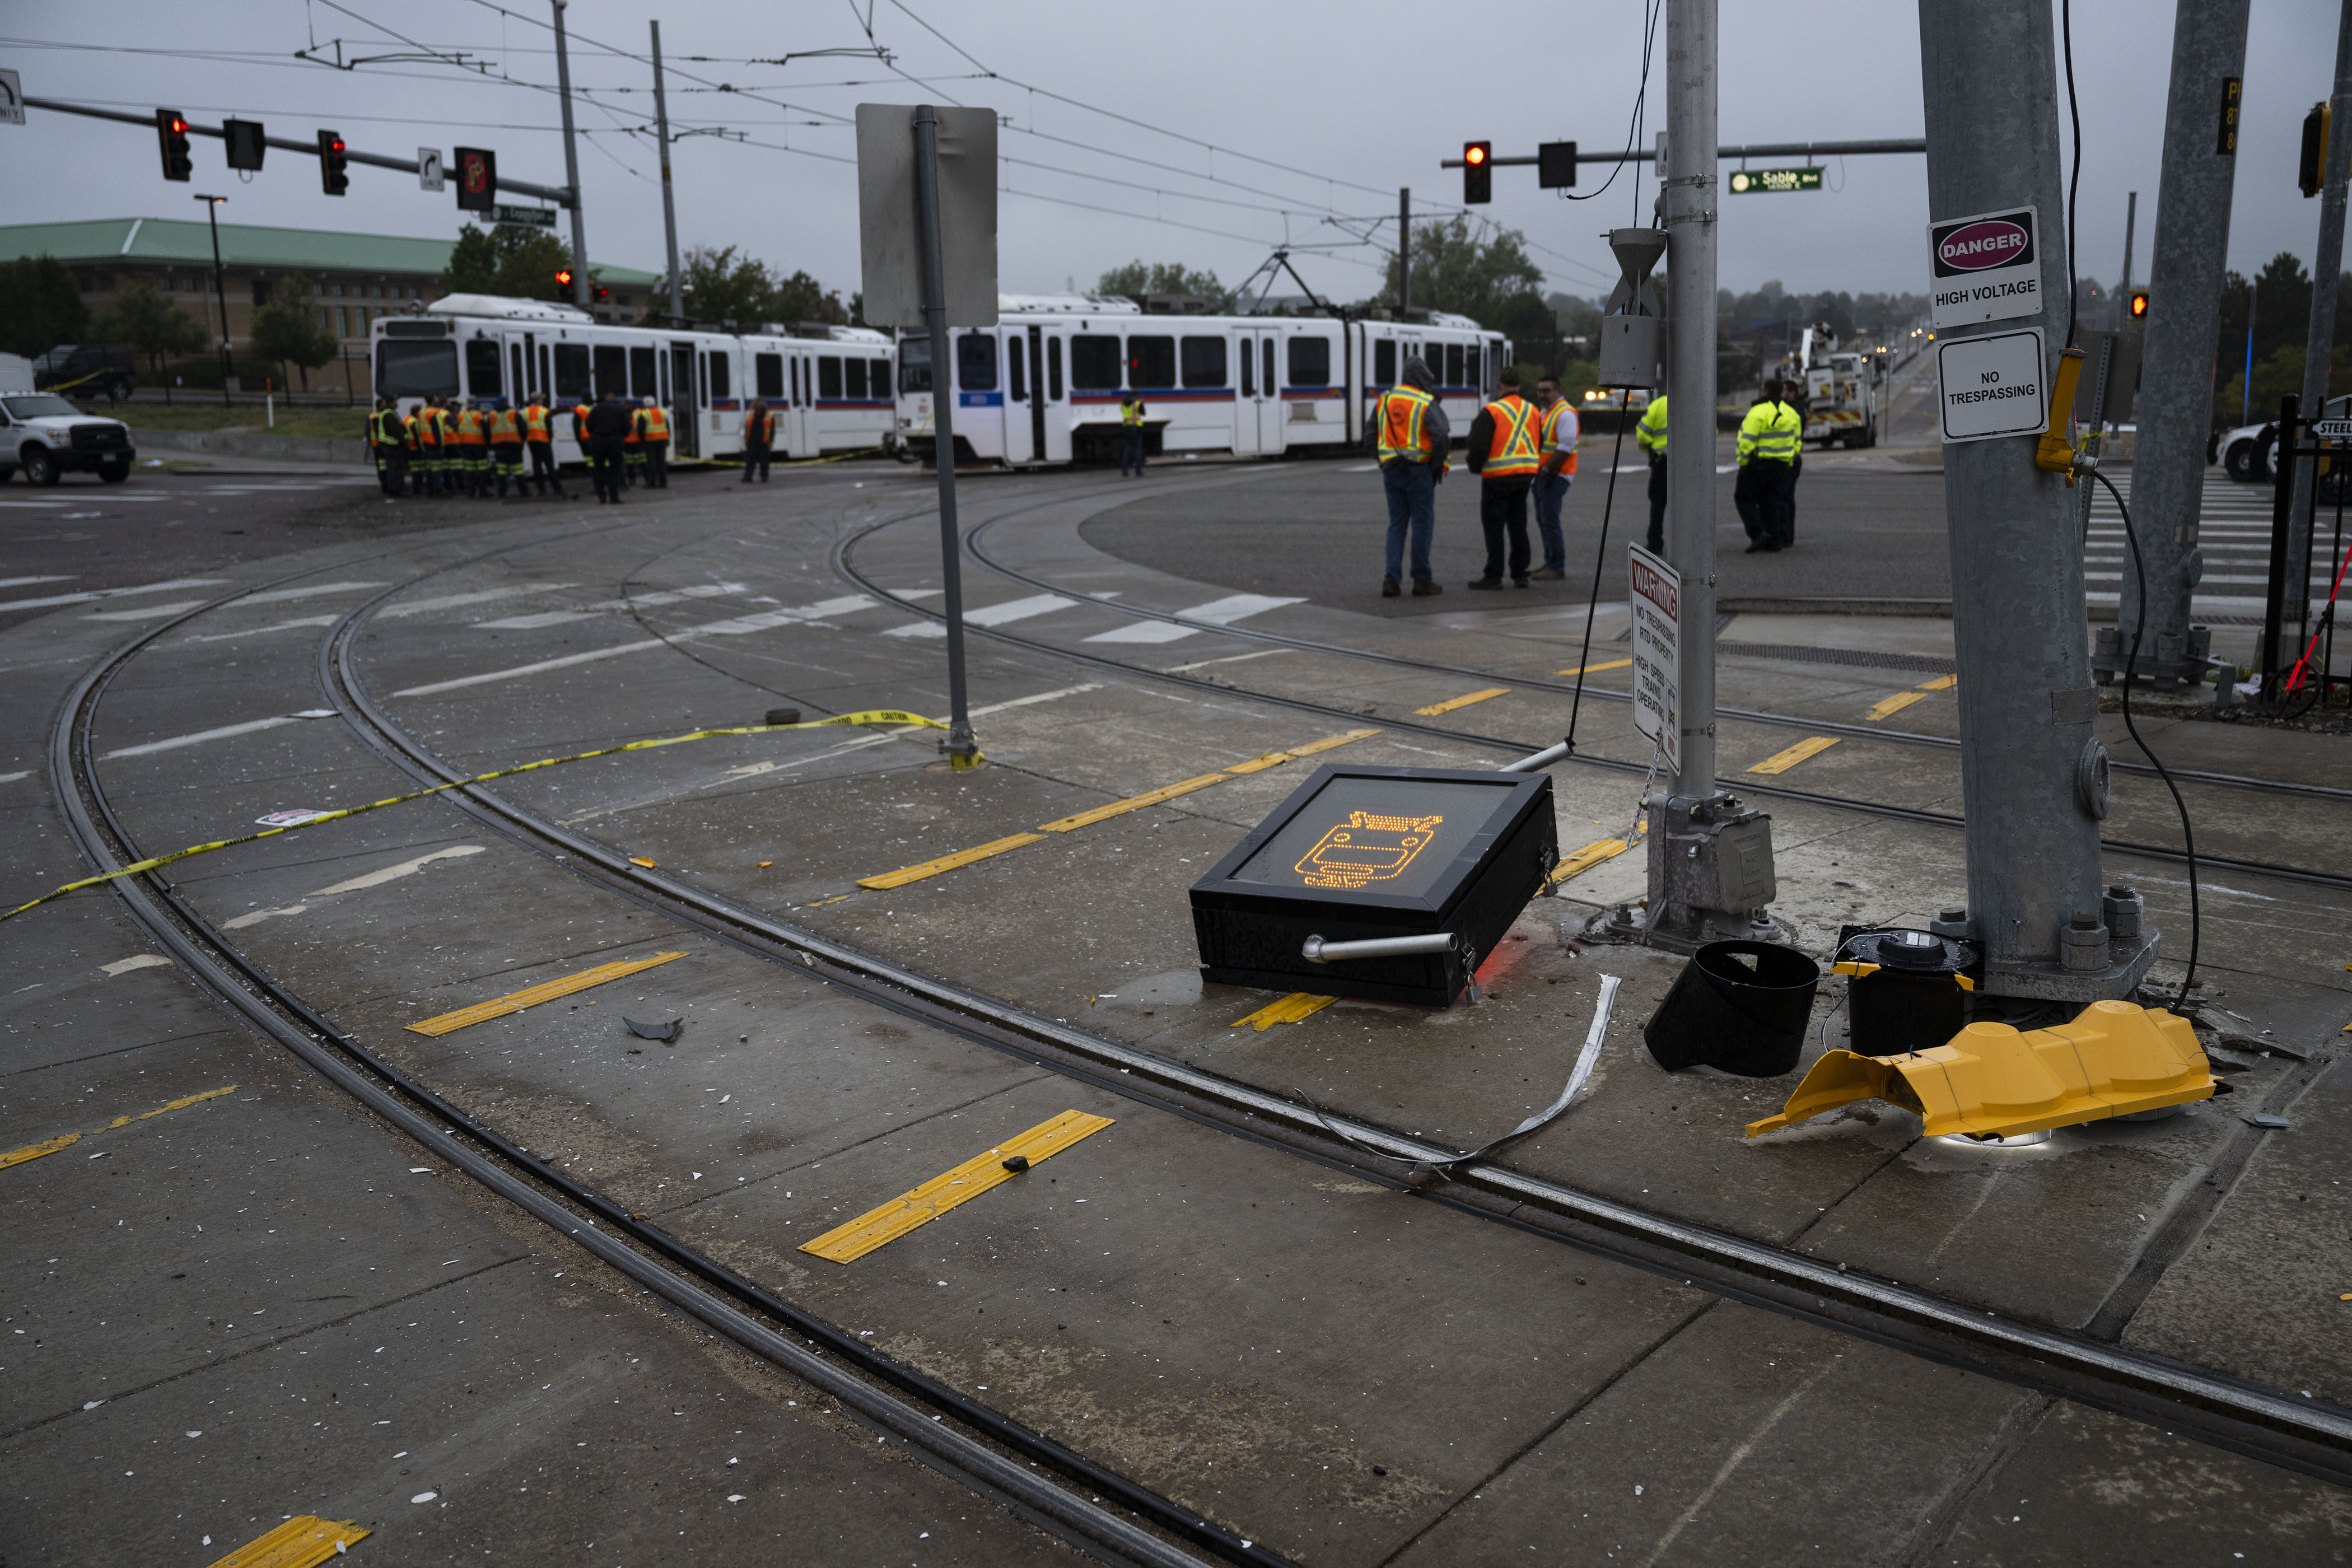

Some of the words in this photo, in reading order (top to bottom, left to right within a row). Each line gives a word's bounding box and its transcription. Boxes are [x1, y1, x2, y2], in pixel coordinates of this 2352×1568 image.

[1762, 170, 1797, 185] Sable
[1944, 233, 2022, 258] DANGER
[1936, 290, 1969, 306] HIGH
[1972, 279, 2036, 301] VOLTAGE
[1981, 371, 1999, 384] NO
[1949, 384, 2035, 405] TRESPASSING
[2320, 422, 2352, 433] STEEL
[1634, 562, 1676, 617] WARNING
[1636, 604, 1644, 620] NO
[1646, 610, 1676, 648] TRESPASSING
[1640, 626, 1650, 643] RTD
[1652, 634, 1674, 666] PROPERTY
[1635, 653, 1649, 673] HIGH
[1650, 664, 1665, 687] SPEED
[1642, 675, 1661, 700] TRAINS
[881, 712, 909, 721] CAUTION
[1637, 689, 1664, 722] OPERATING
